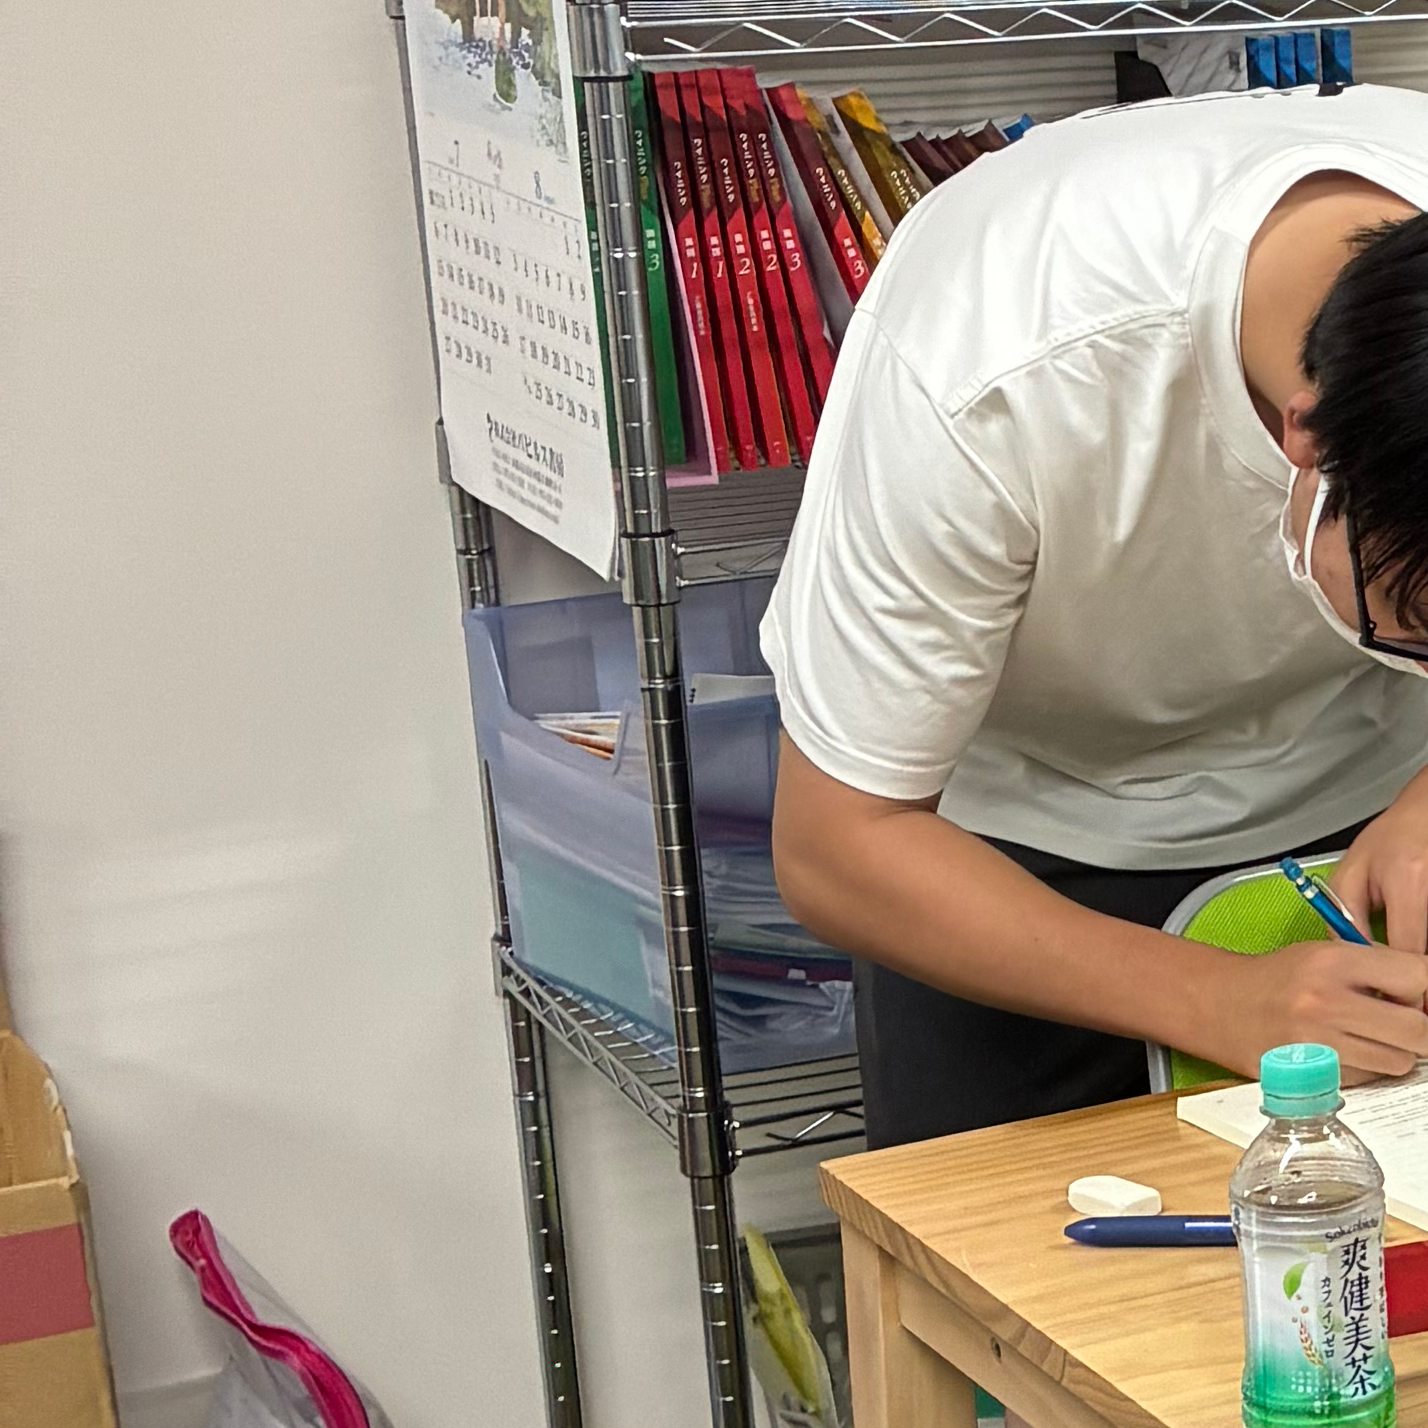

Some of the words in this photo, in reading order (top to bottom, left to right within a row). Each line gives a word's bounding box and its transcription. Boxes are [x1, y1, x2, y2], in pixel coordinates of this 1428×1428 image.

[1321, 1277, 1335, 1358] カフェインゼロ
[1339, 1237, 1380, 1398] 爽健美茶
